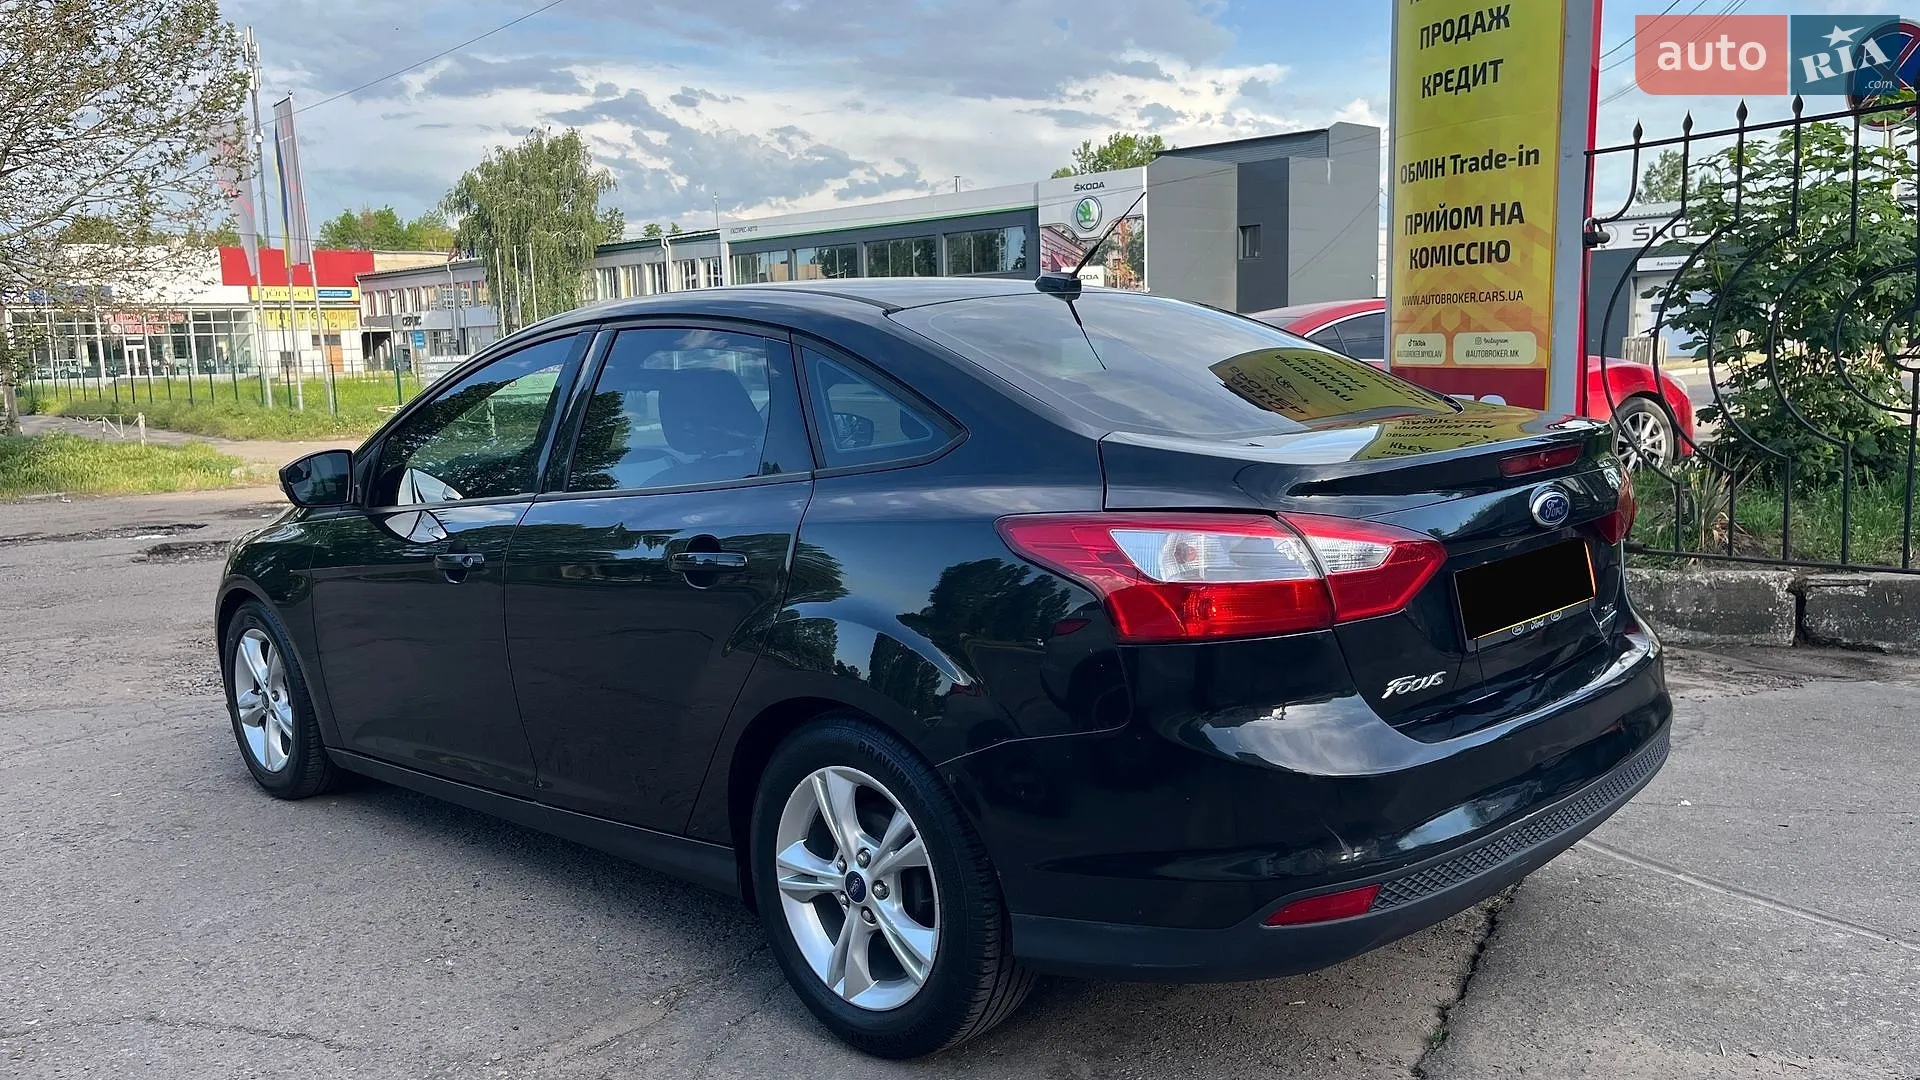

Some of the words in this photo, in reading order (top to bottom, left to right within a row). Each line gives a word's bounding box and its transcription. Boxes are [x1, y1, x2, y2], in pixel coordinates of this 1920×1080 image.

[1420, 4, 1511, 50] ПРОДАЖ
[1421, 58, 1504, 99] КРЕДИТ
[1400, 156, 1446, 185] ОБМІН
[1449, 144, 1540, 175] Trade-in
[1073, 182, 1105, 193] ŠKODA
[1405, 203, 1483, 236] ПРИЙОМ
[1489, 201, 1525, 226] НА
[1409, 239, 1511, 270] КОМІССІЮ
[1402, 290, 1524, 306] WWW.AUTOBROKER.CARS.UA
[1545, 498, 1564, 520] Ford
